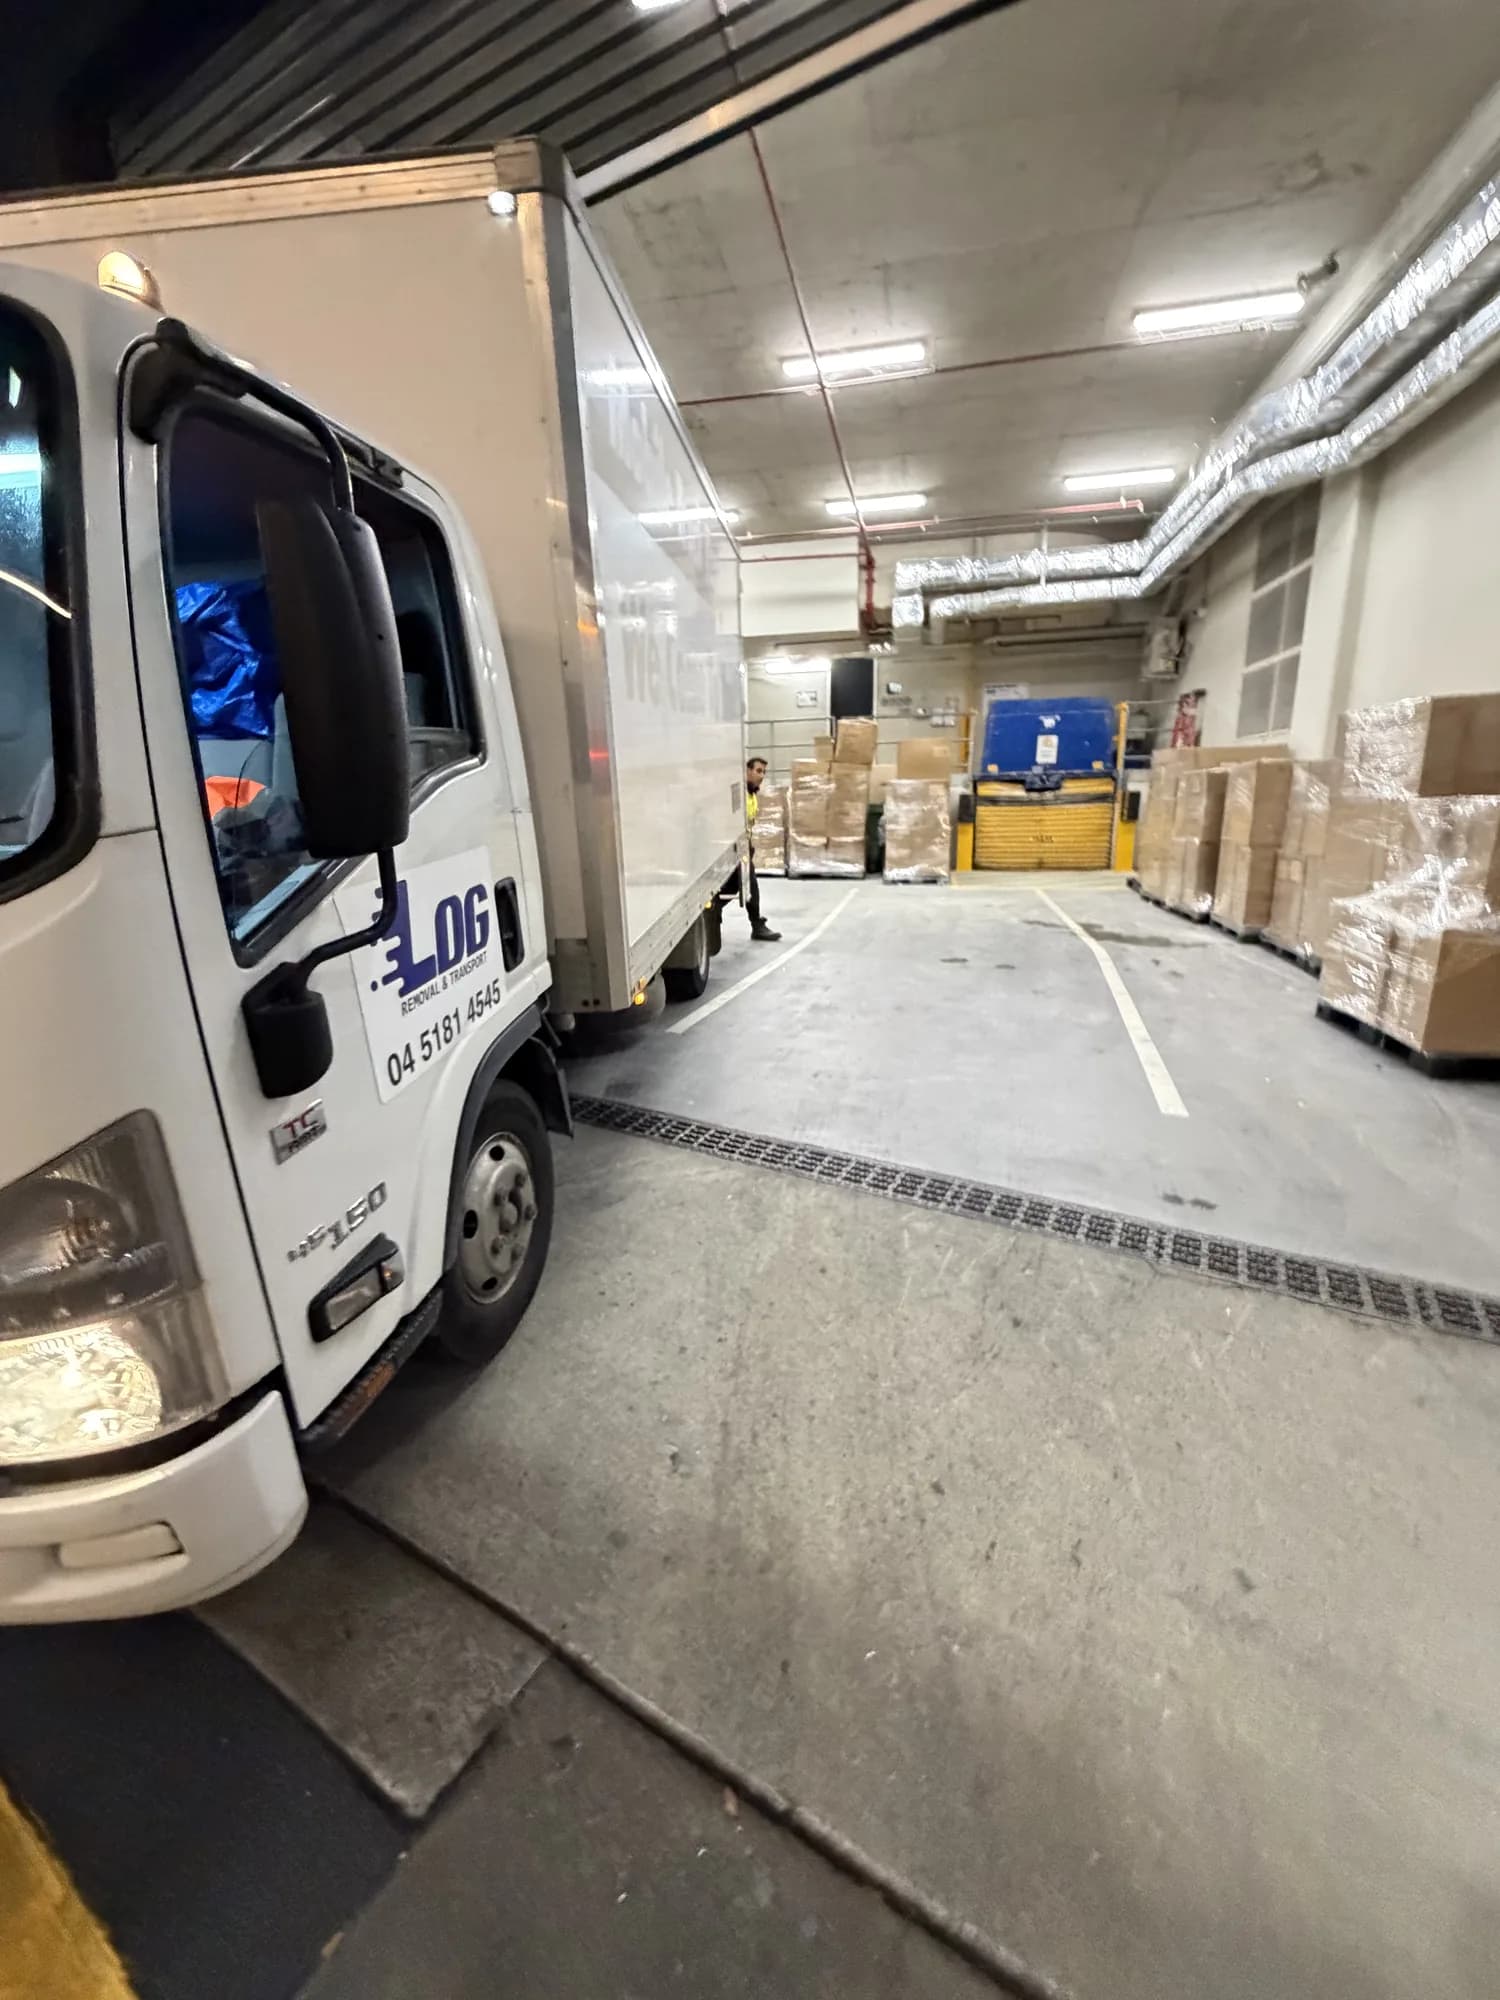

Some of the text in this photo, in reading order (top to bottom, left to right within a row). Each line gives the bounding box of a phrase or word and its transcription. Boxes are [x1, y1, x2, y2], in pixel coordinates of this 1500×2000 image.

[380, 878, 490, 998] LOG
[401, 951, 487, 1017] REMOVAL & TRANSPORT
[387, 978, 501, 1086] 04 5181 4545
